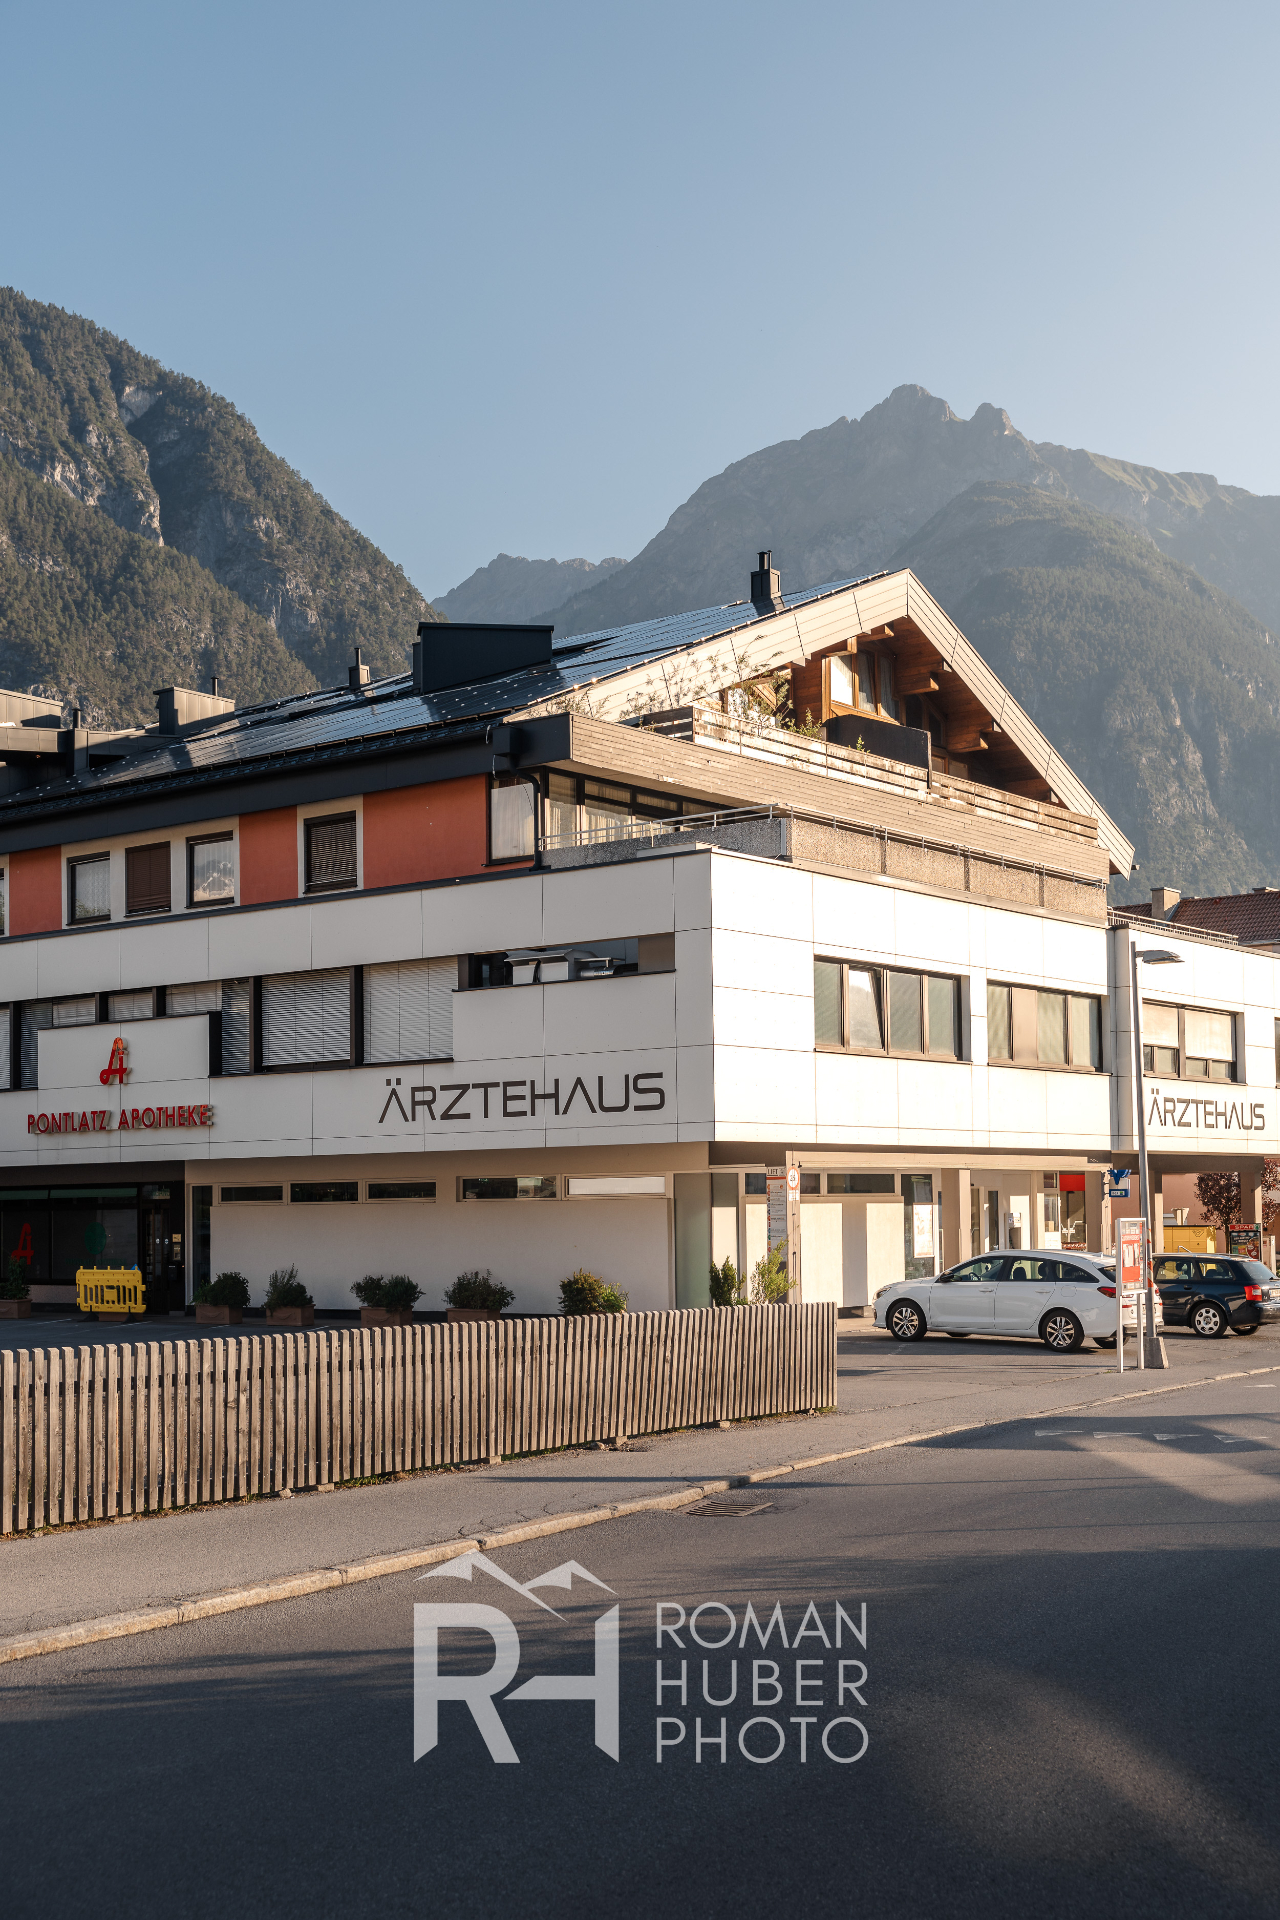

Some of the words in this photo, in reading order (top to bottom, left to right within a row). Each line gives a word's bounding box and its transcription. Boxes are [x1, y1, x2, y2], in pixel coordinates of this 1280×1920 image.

[378, 1072, 666, 1123] ÄRZTEHAUS
[1148, 1088, 1265, 1131] ÄRZTEHAUS
[27, 1110, 108, 1134] PONTLATZ
[118, 1105, 209, 1130] APOTHEKE
